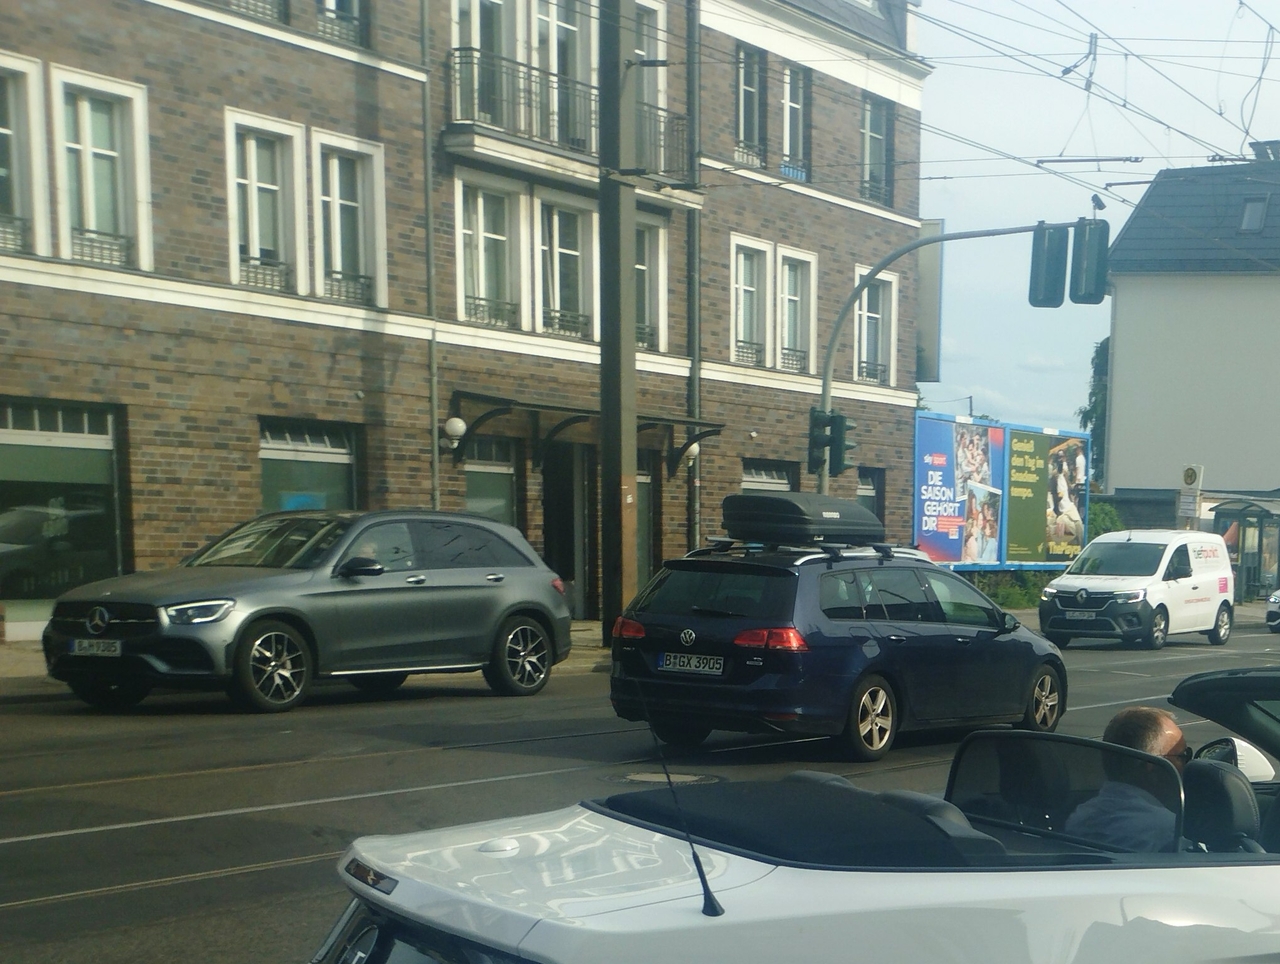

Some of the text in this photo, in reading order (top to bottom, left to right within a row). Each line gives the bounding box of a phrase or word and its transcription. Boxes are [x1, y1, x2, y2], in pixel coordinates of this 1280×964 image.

[923, 453, 933, 466] sky
[1011, 454, 1045, 471] den Tag im
[927, 470, 943, 486] DIE
[920, 485, 954, 501] SAISON
[924, 501, 961, 517] GEHÖRT
[922, 516, 937, 531] DIR
[664, 654, 723, 671] B GX 3905
